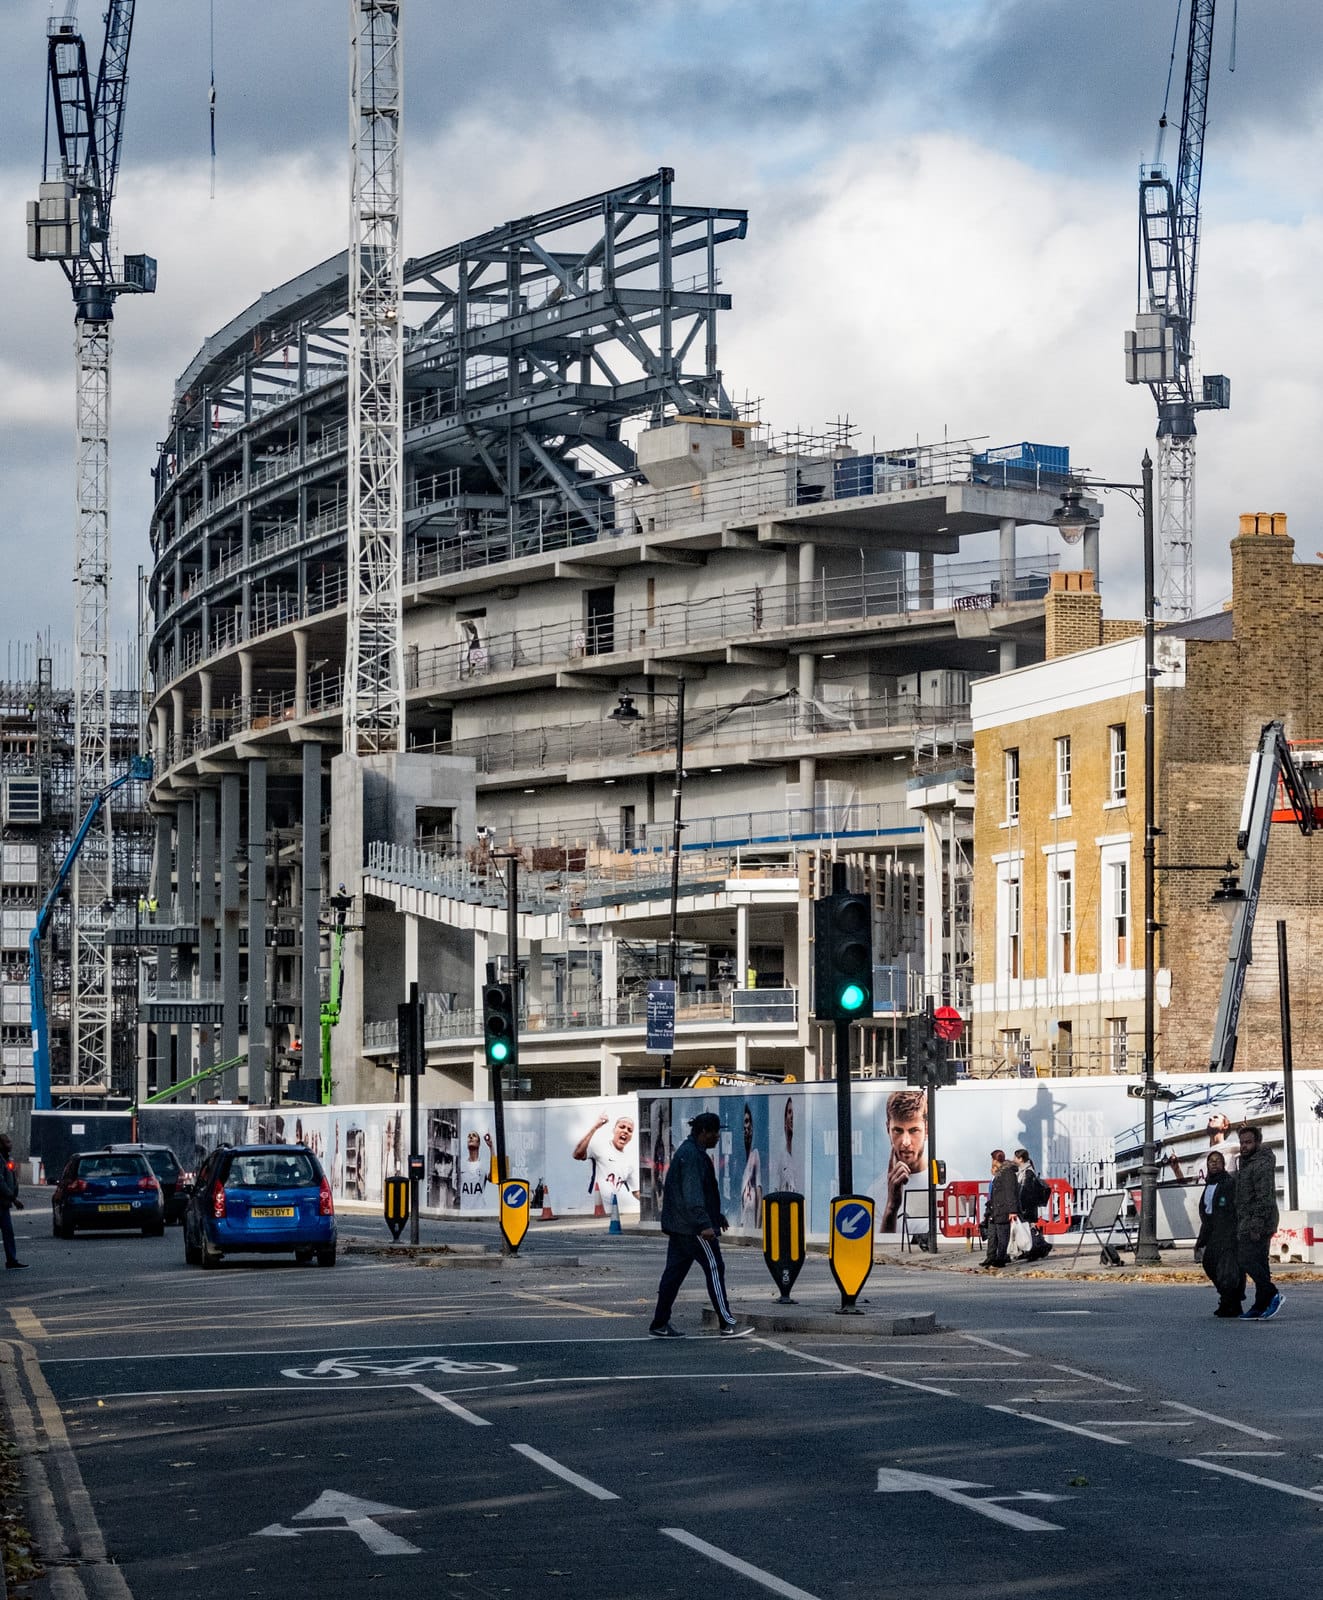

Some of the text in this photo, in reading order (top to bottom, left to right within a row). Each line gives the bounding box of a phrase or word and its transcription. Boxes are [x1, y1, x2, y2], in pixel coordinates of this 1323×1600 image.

[1103, 1163, 1117, 1189] IN
[462, 1183, 483, 1194] AIA
[254, 1208, 274, 1216] HN53
